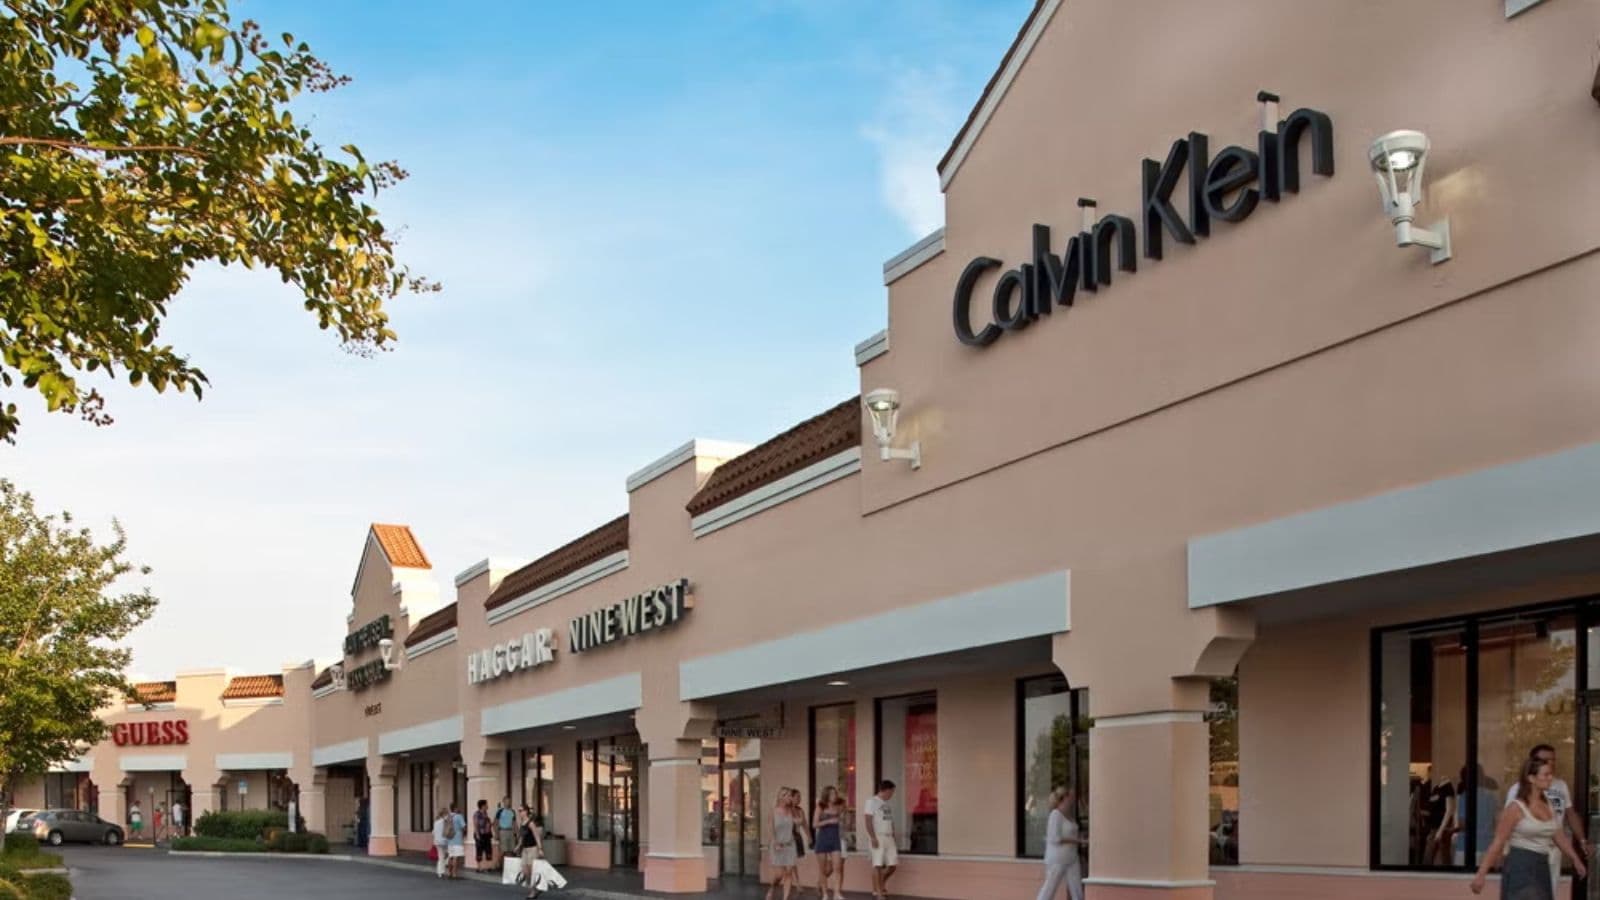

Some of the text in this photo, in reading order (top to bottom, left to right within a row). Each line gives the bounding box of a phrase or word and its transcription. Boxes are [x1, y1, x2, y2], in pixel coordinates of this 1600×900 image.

[953, 91, 1335, 347] Calvin Klein
[569, 579, 686, 653] NINE WEST
[467, 628, 554, 685] HAGGAR
[112, 720, 189, 747] GUESS
